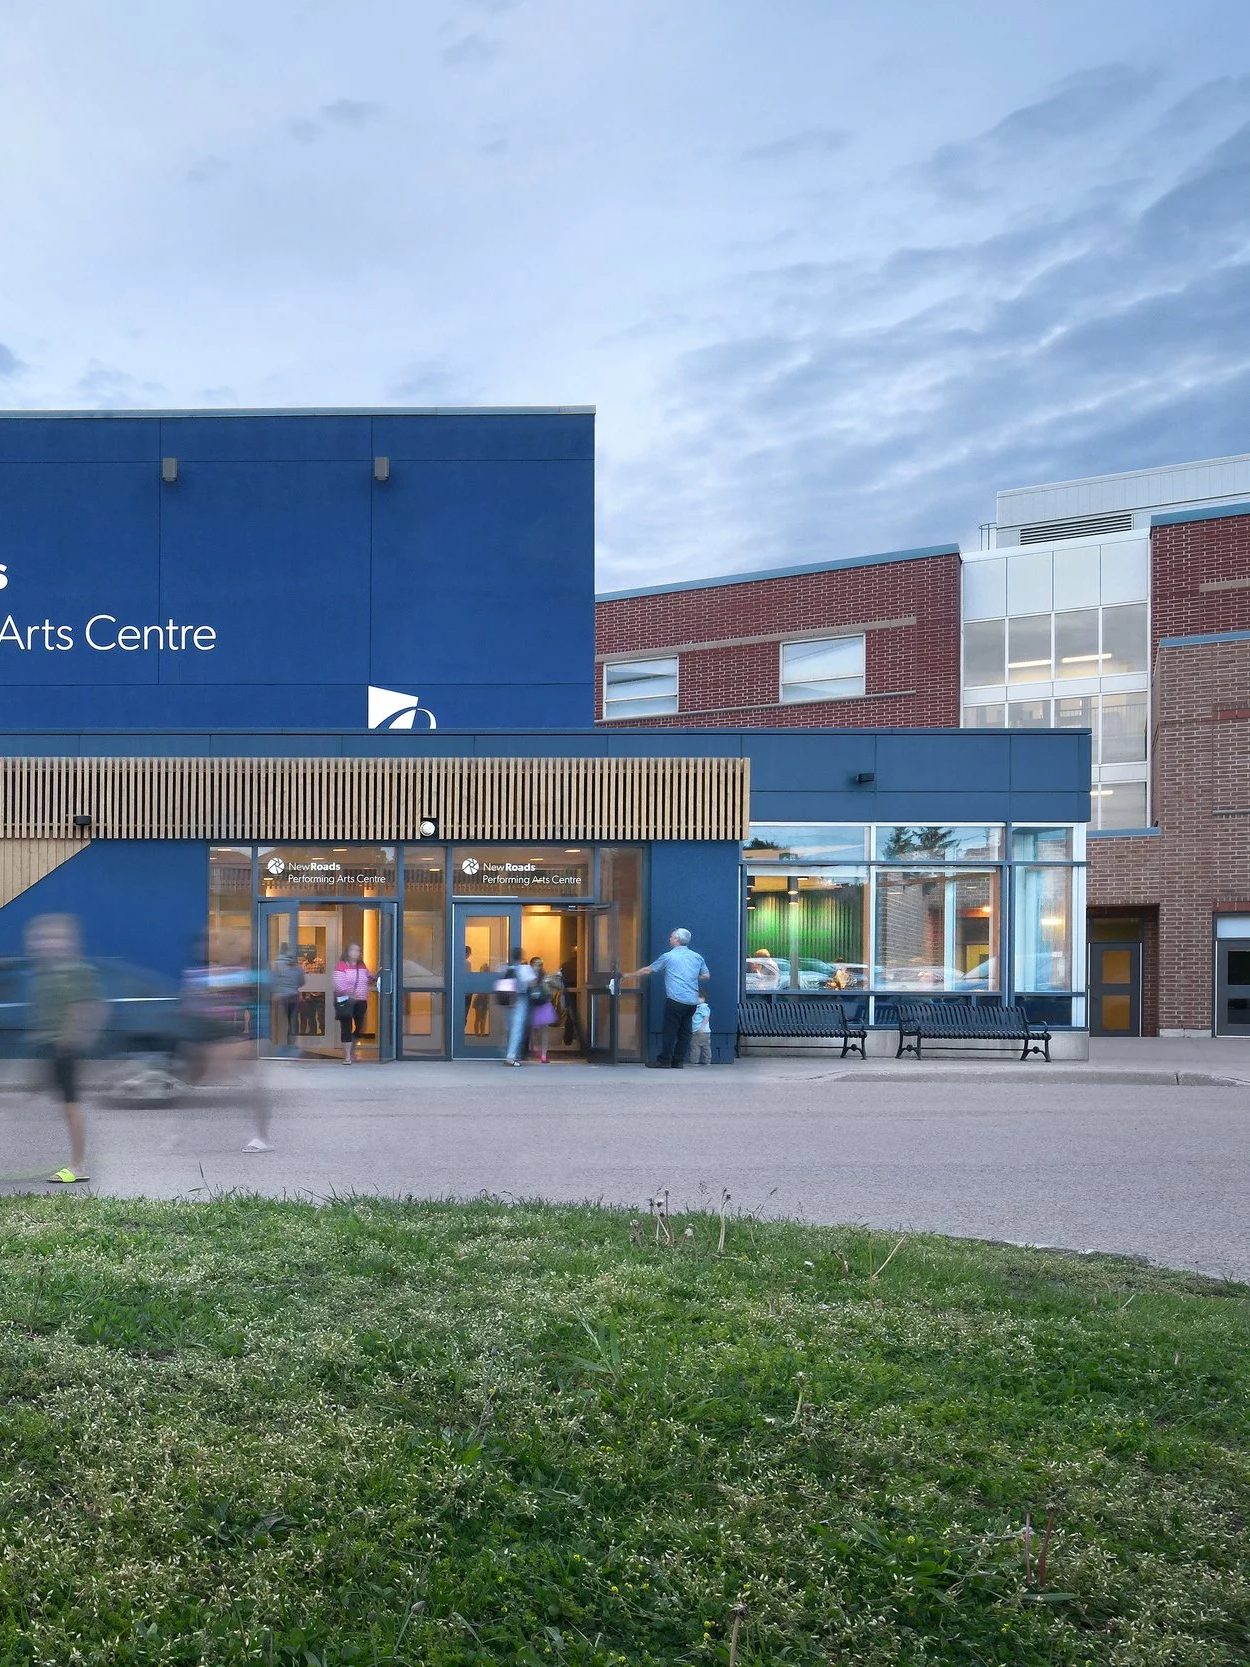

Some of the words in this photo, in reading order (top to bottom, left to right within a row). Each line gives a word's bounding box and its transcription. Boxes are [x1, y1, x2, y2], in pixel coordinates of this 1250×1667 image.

[85, 615, 217, 651] Centre
[288, 874, 335, 884] Performing
[337, 874, 355, 883] Arts
[356, 874, 386, 883] Centre
[482, 875, 530, 886] Performing
[551, 875, 582, 885] Centre
